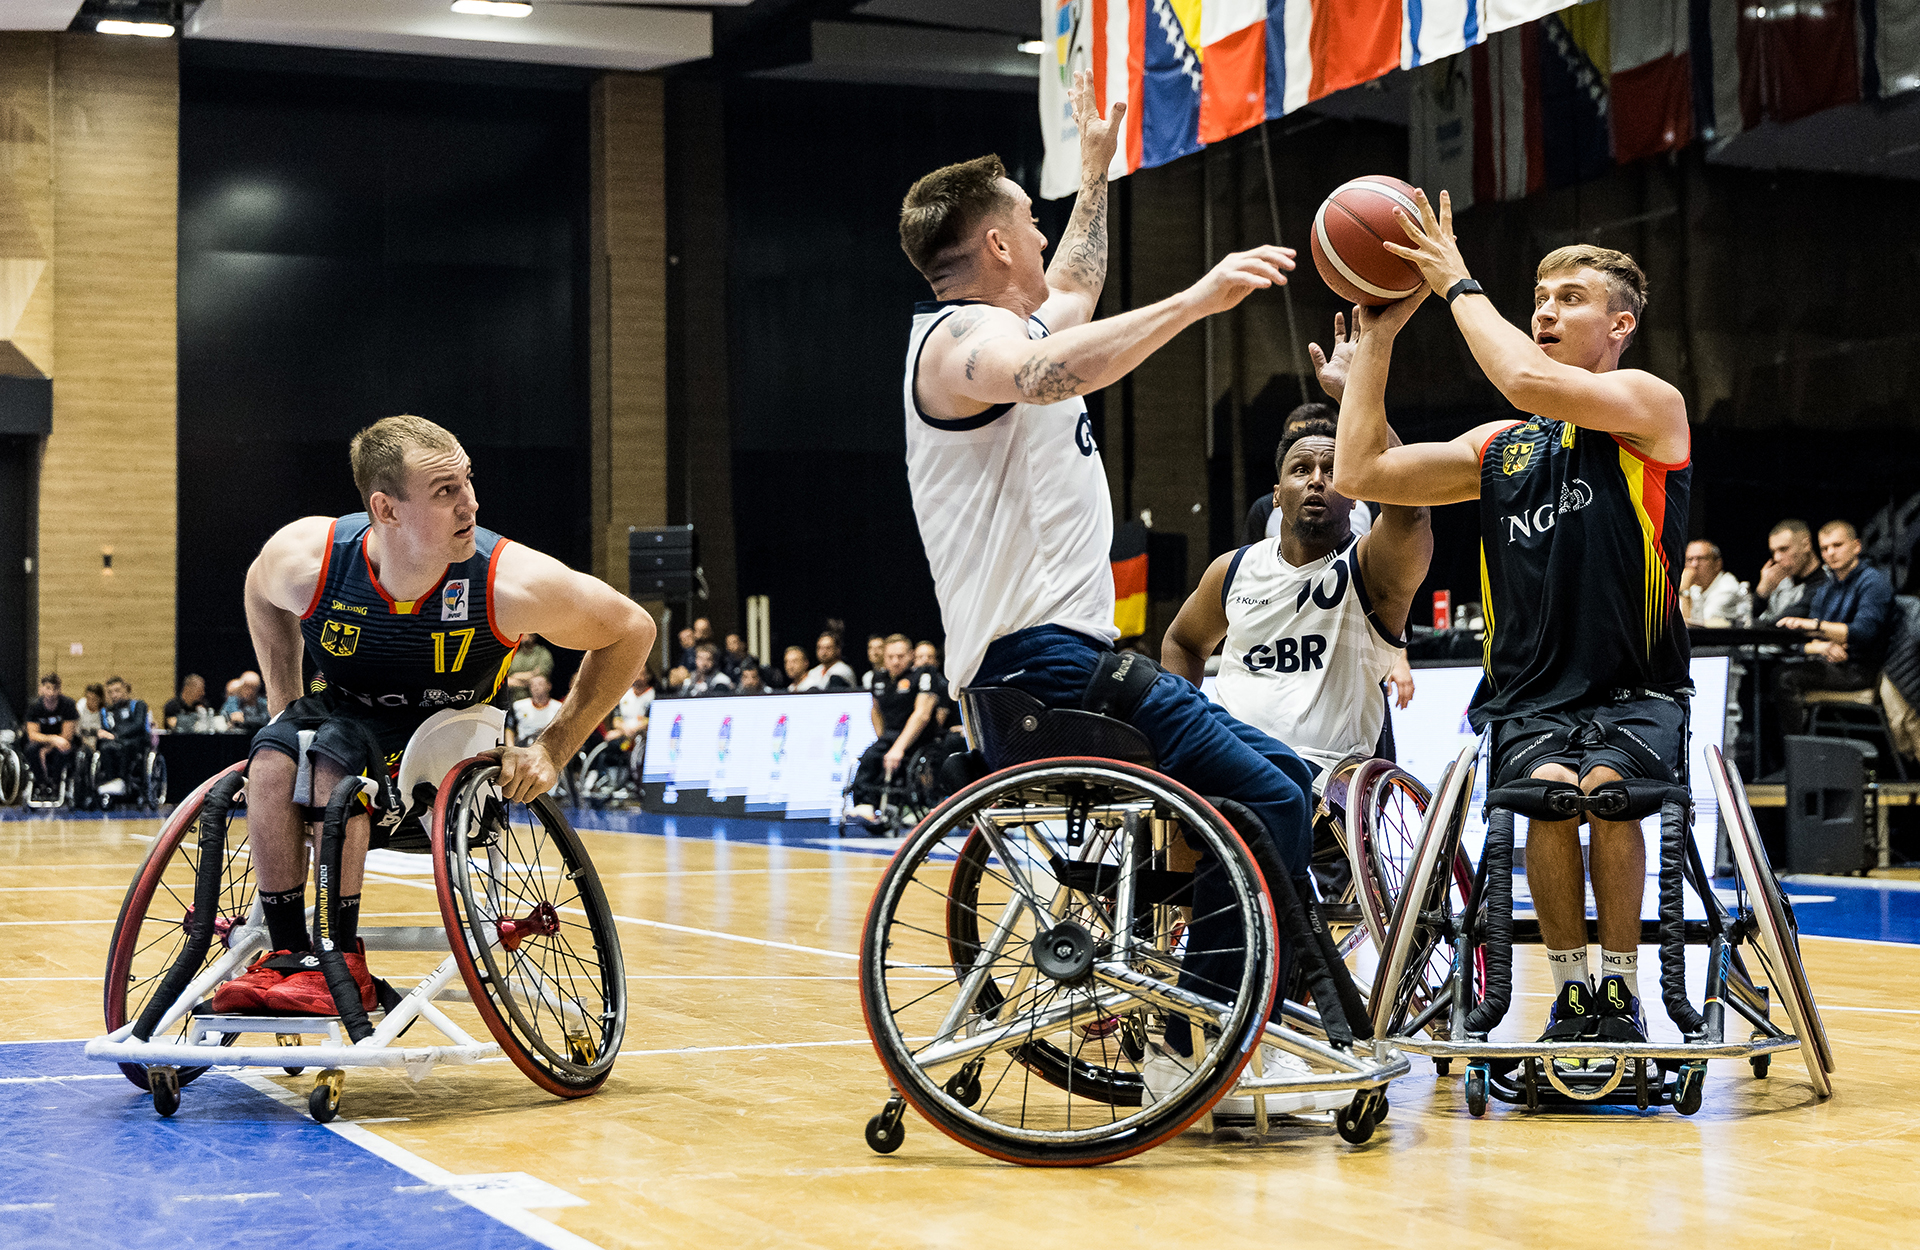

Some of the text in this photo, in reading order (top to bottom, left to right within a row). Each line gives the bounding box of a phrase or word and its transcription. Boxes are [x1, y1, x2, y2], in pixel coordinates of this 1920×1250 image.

[1500, 503, 1556, 543] NG
[331, 599, 369, 616] SPALDING
[430, 627, 476, 673] 17
[1242, 634, 1327, 673] GBR
